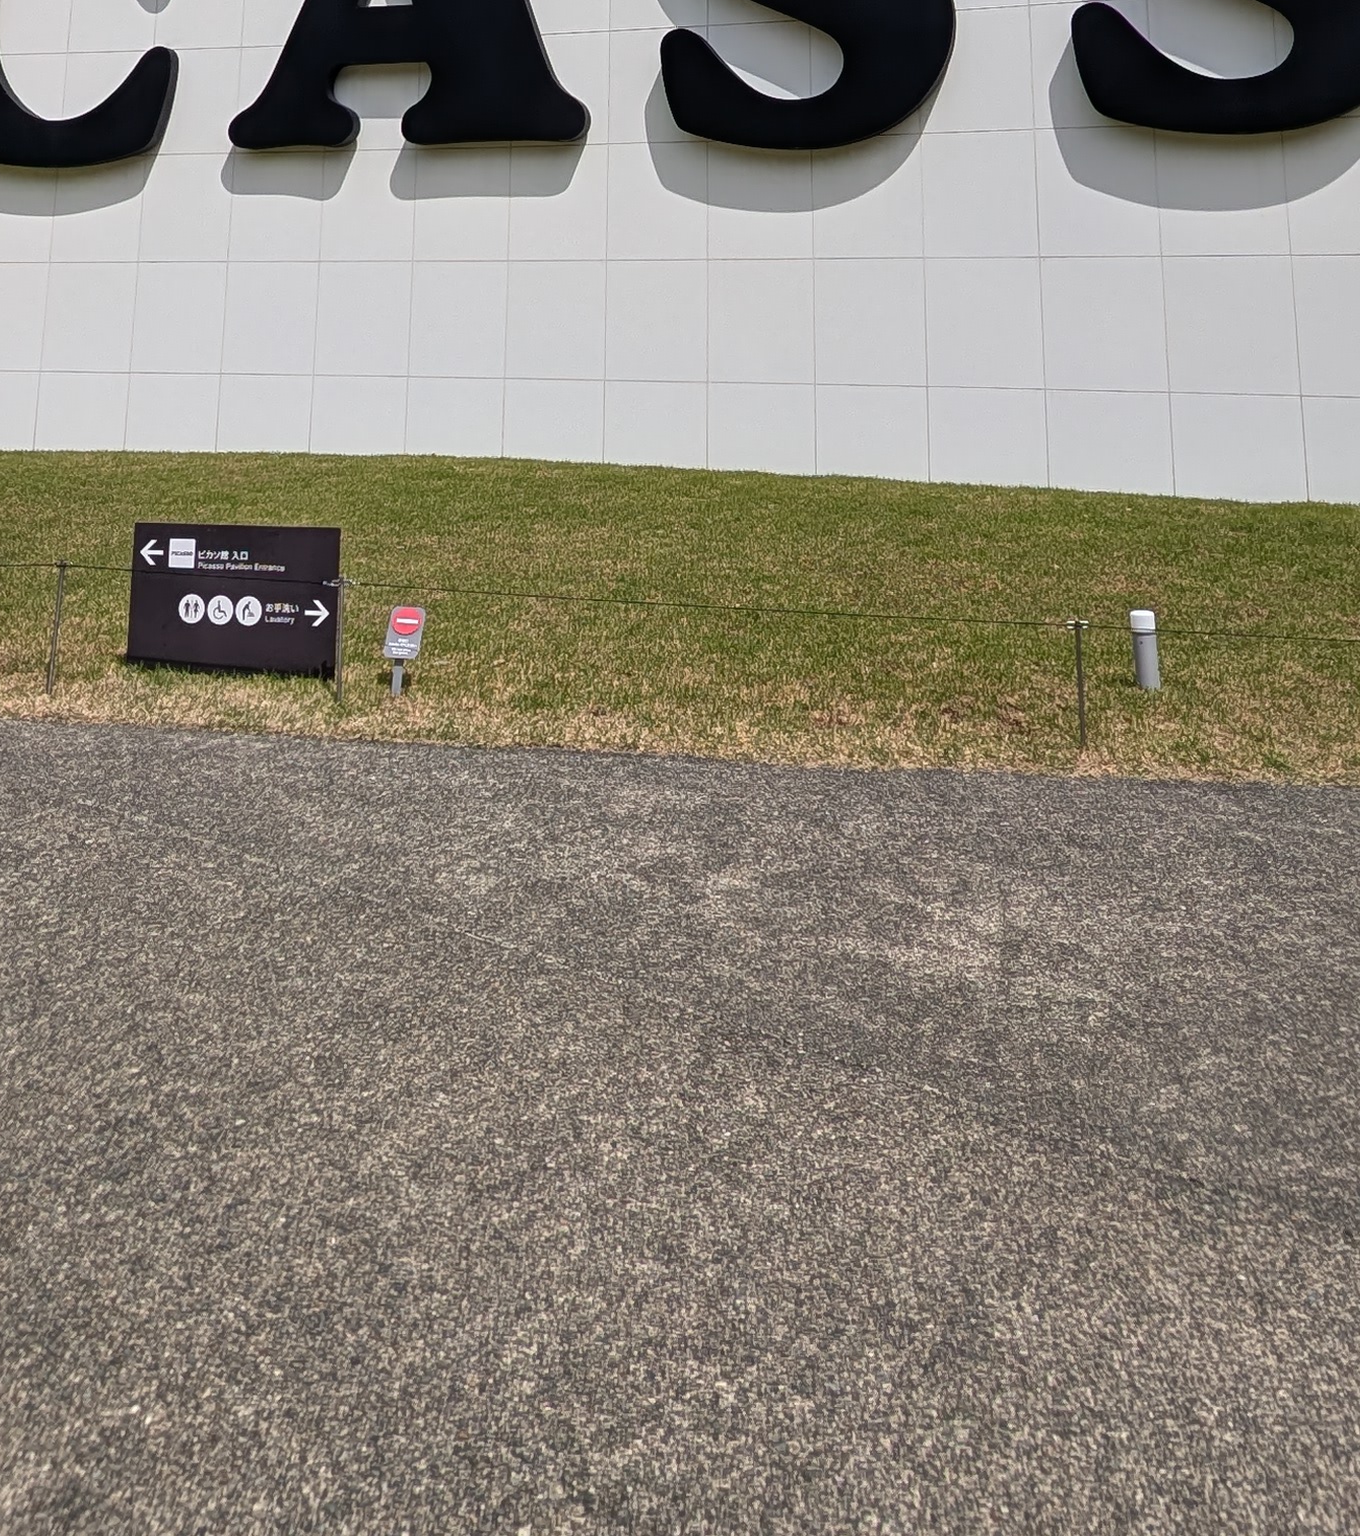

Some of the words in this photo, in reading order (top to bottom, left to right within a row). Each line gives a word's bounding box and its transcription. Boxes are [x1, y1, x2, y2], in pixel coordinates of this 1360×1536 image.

[232, 551, 248, 560] 入口
[198, 561, 224, 570] Picasso
[225, 562, 253, 571] Pavilion
[254, 563, 285, 572] Entrance
[265, 602, 300, 613] お手洗い
[265, 615, 295, 625] Lavatory
